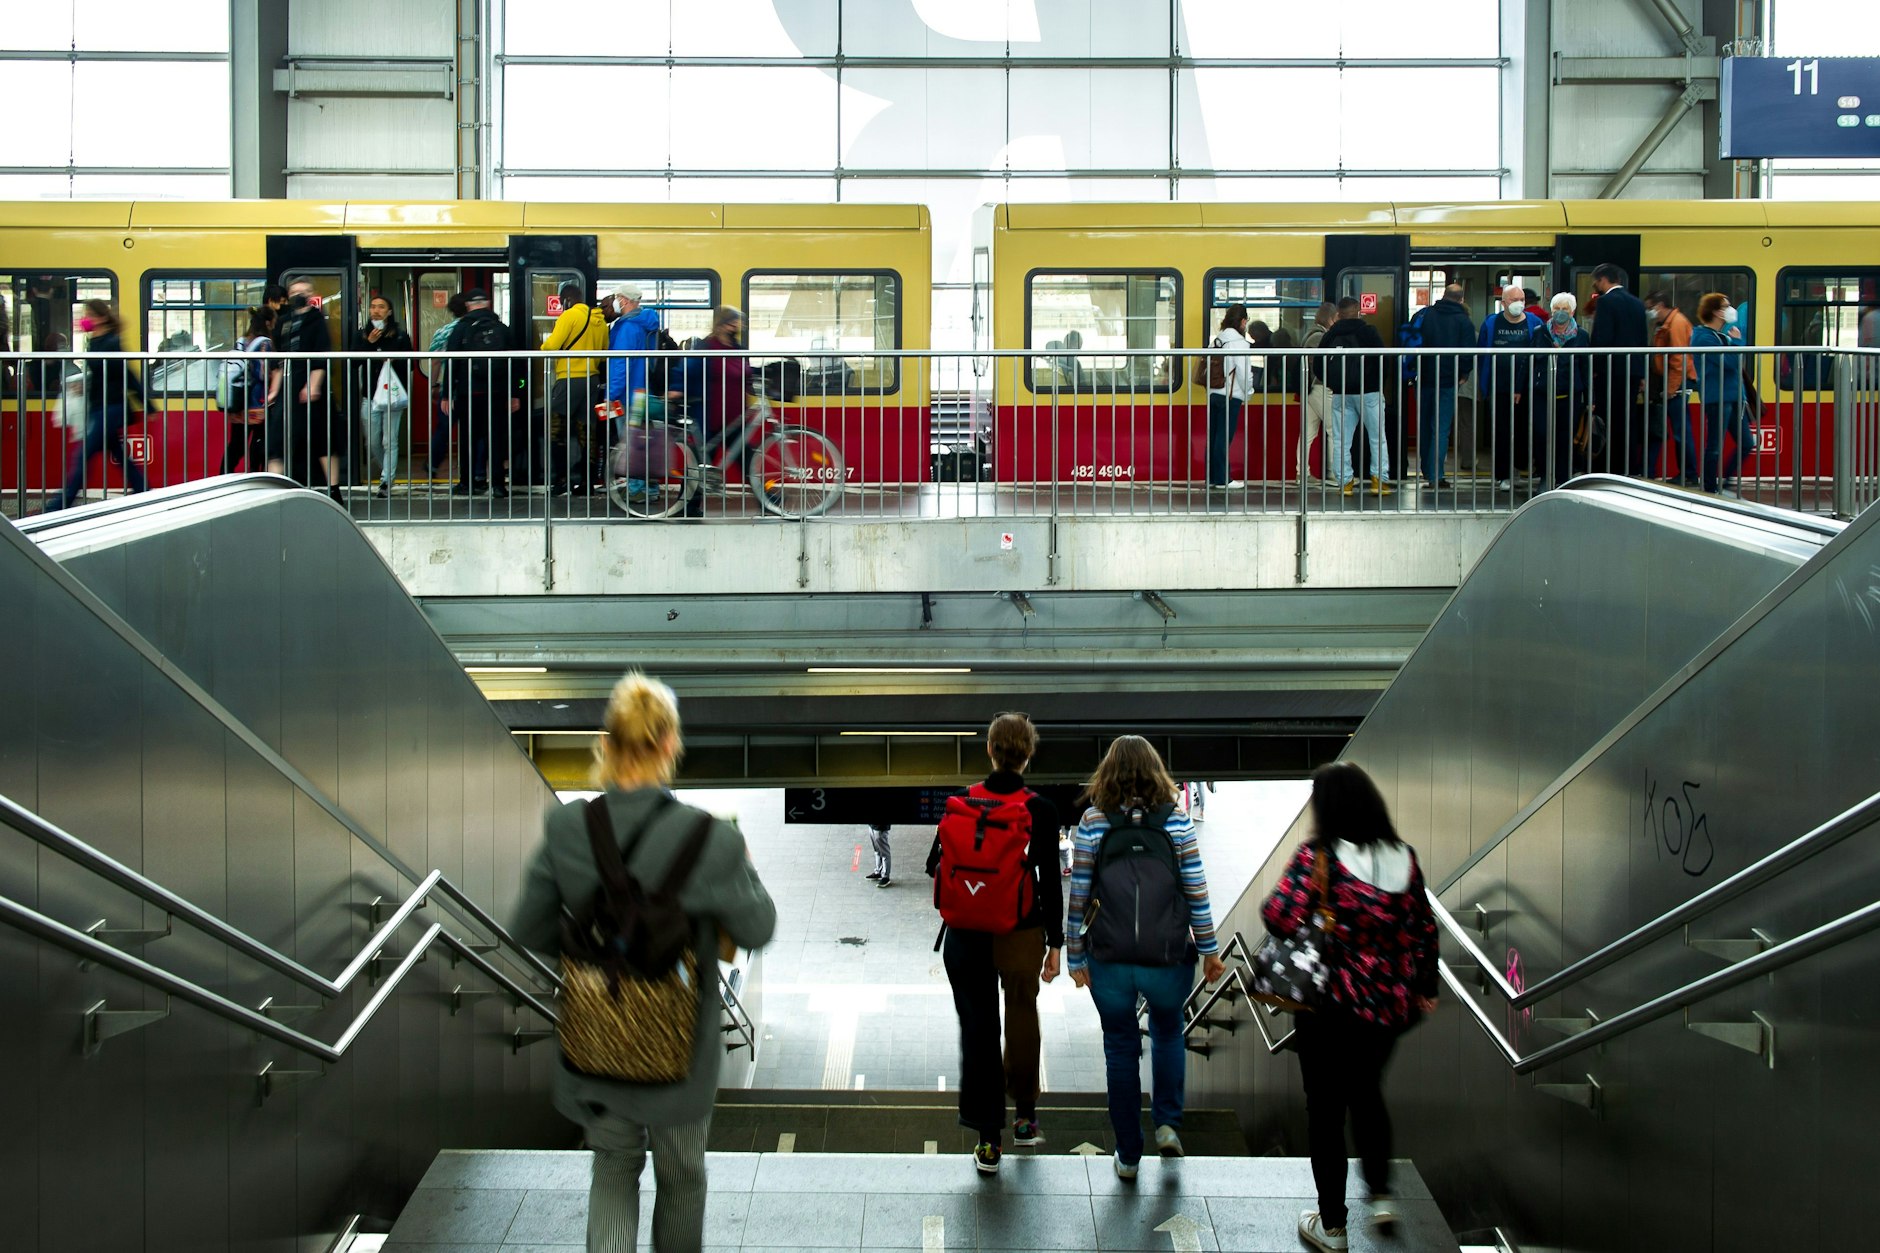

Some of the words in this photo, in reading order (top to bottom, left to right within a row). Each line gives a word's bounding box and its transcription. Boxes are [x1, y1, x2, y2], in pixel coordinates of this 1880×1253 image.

[1787, 60, 1819, 95] 11
[1840, 97, 1859, 108] S41
[1840, 115, 1857, 127] S8
[817, 467, 855, 480] 062-7
[1071, 465, 1094, 477] 482
[1098, 465, 1136, 477] 490-0
[811, 788, 826, 811] 3
